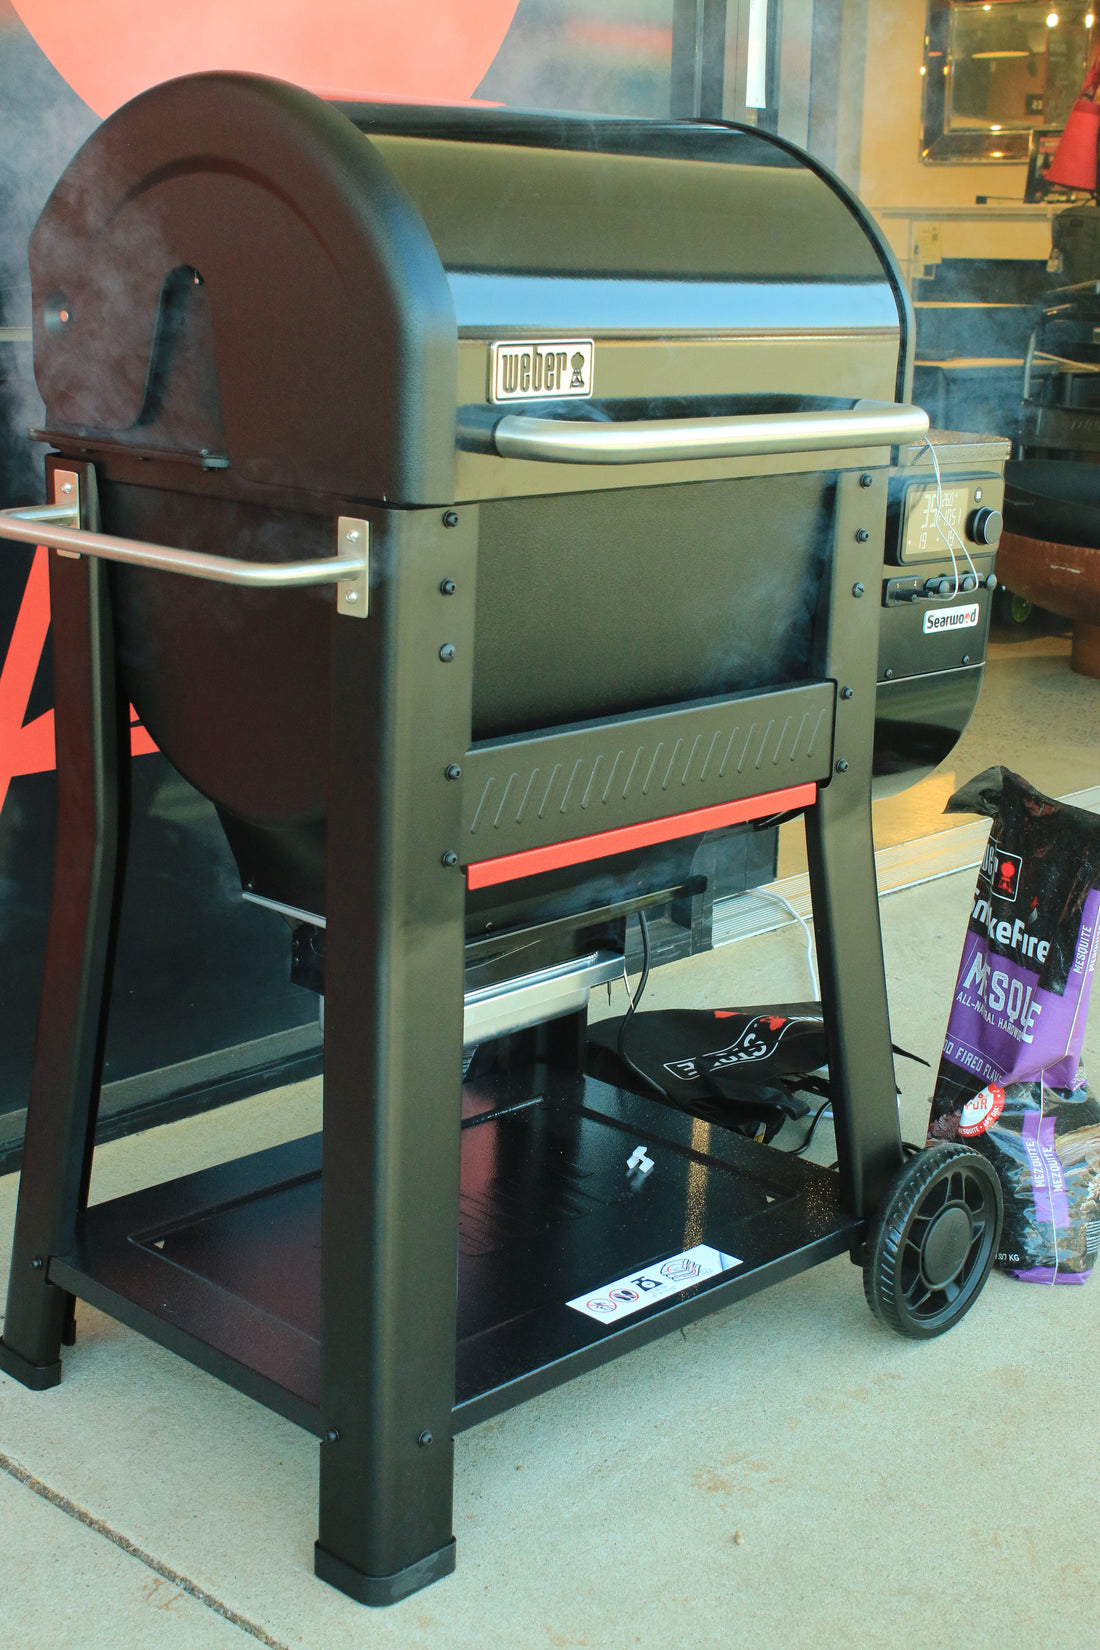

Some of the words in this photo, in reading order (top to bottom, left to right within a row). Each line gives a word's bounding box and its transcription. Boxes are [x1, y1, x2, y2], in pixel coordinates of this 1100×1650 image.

[502, 345, 567, 393] weber
[926, 608, 977, 629] Searwood
[1072, 925, 1092, 974] MESQUITE
[955, 1047, 984, 1072] FIRED
[1025, 1140, 1046, 1188] MEZQUITE
[1042, 1146, 1064, 1193] MEZQUITE
